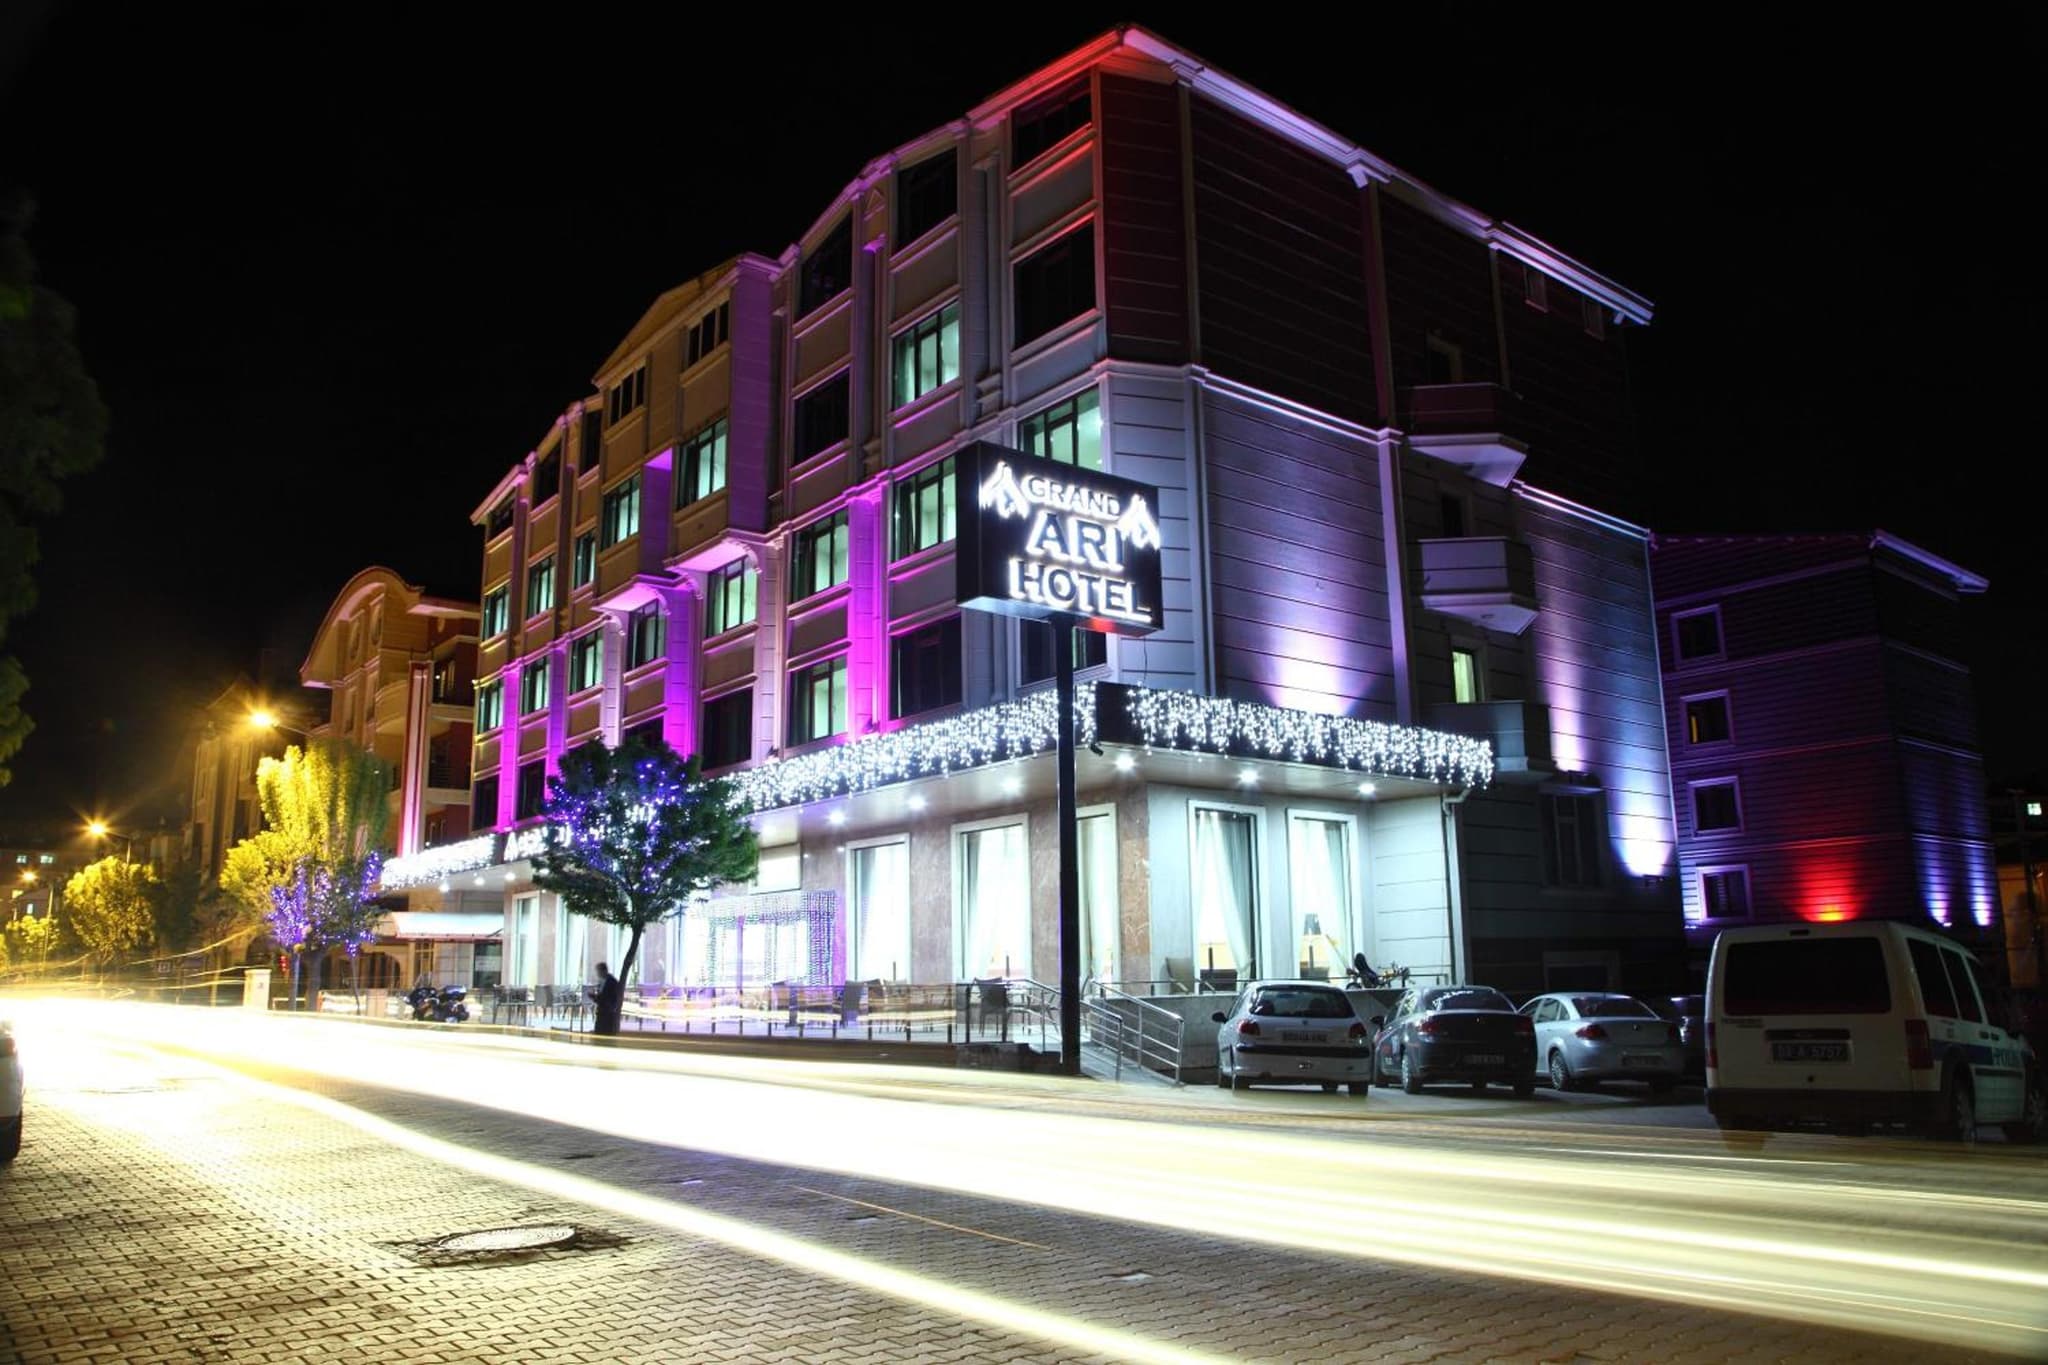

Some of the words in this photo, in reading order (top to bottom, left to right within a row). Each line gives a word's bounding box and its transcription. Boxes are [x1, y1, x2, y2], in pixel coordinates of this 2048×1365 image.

[1021, 475, 1120, 521] GRAND
[1026, 510, 1125, 571] ARI
[1009, 557, 1152, 622] HOTEL
